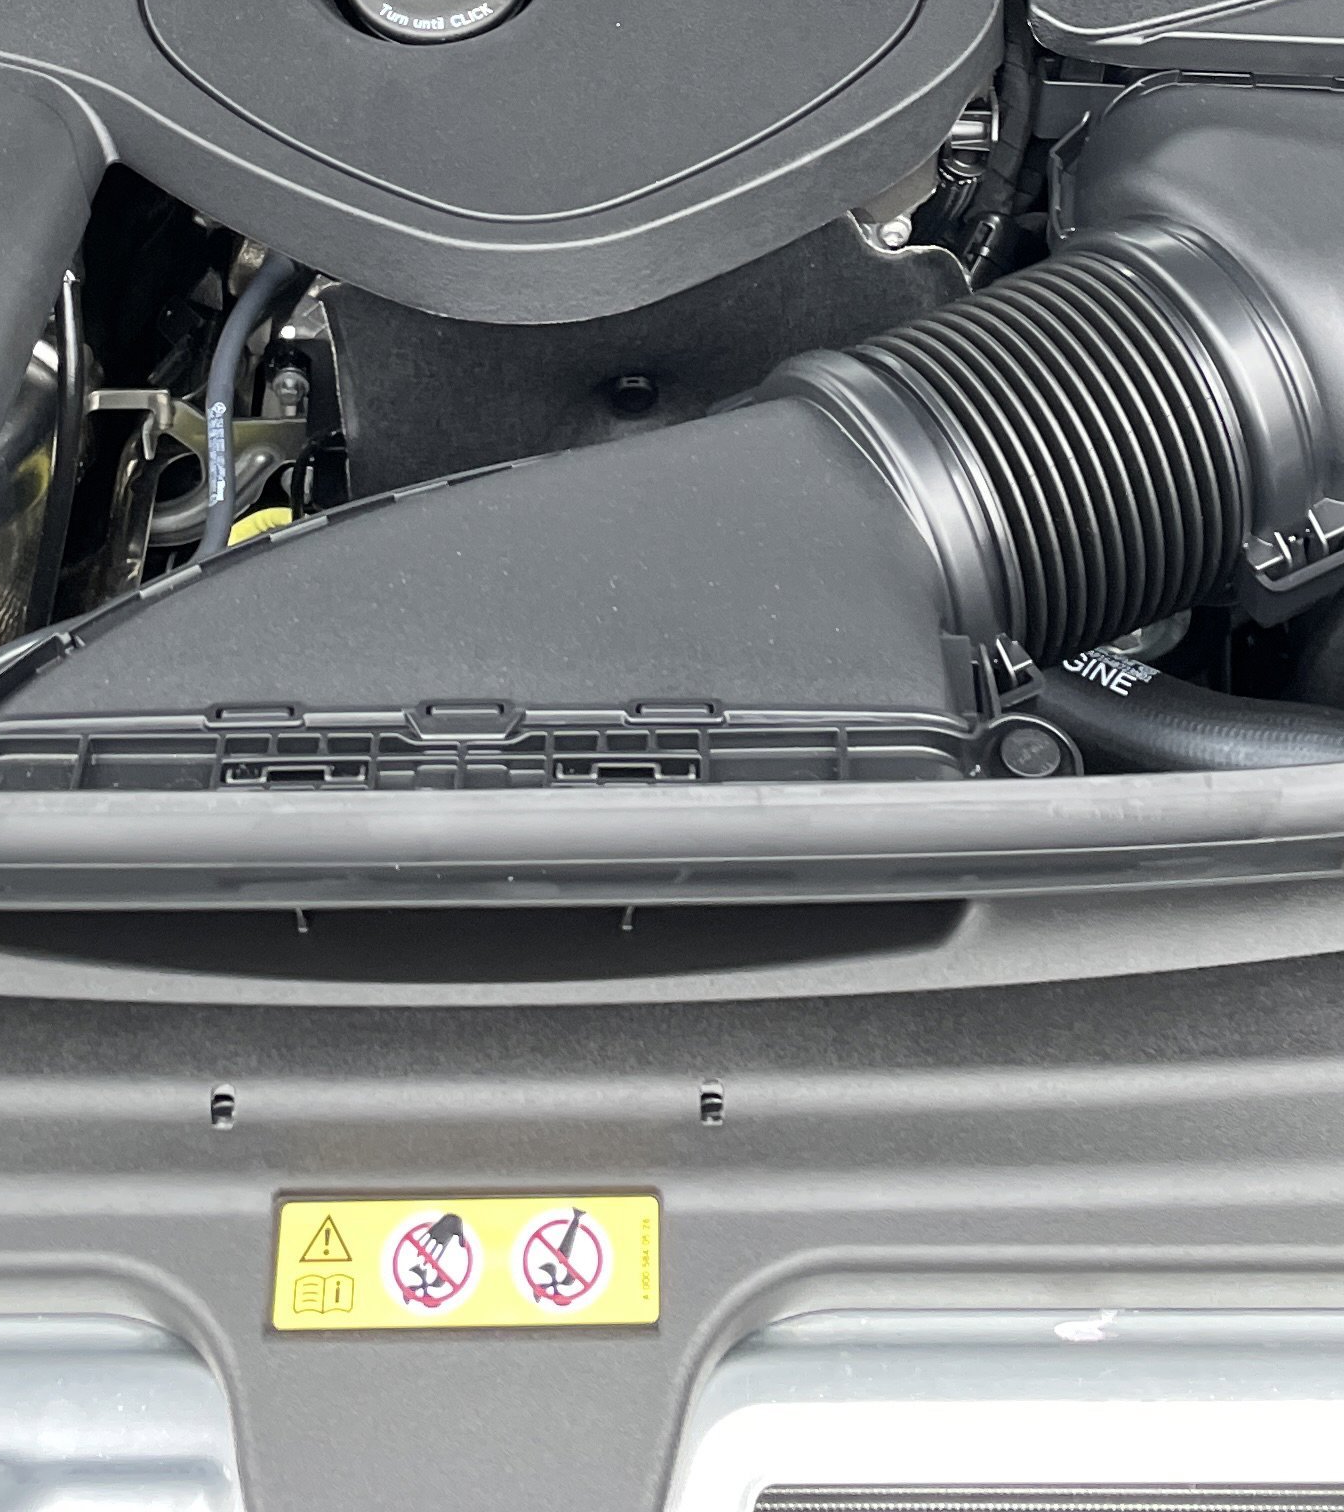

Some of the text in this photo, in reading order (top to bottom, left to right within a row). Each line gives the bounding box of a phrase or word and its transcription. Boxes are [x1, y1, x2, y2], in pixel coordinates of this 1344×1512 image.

[379, 2, 494, 30] Turn until CLICK
